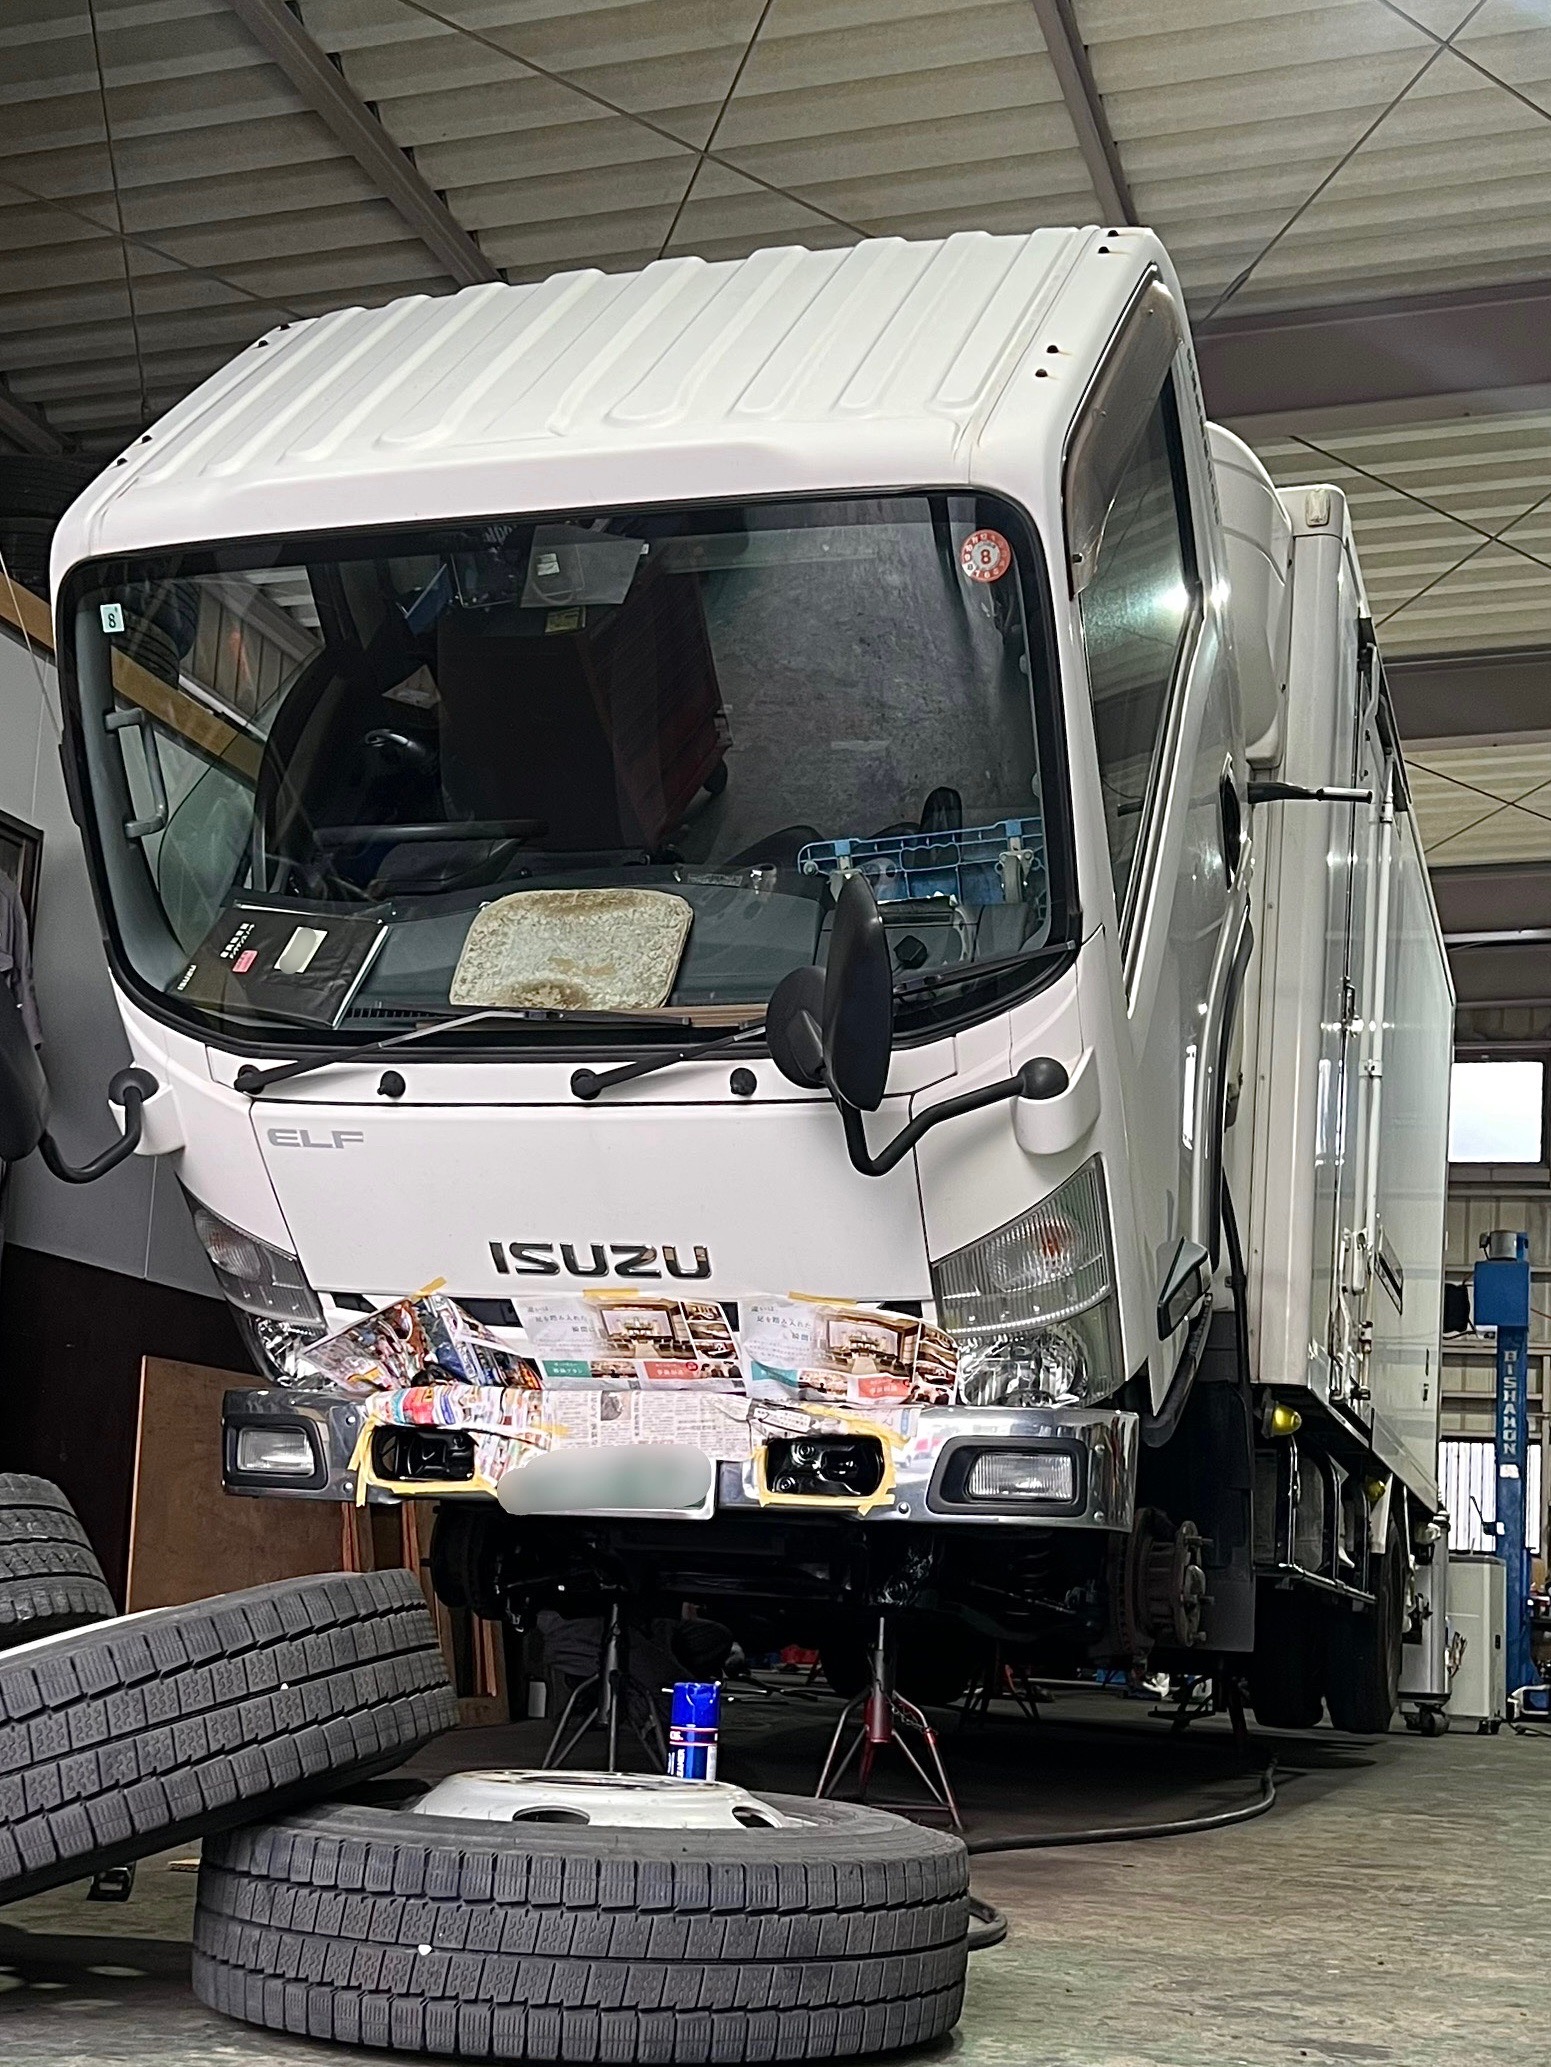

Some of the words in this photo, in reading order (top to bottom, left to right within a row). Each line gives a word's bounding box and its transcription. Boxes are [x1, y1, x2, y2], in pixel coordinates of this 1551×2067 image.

[981, 549, 991, 565] 8
[108, 613, 116, 629] 8
[267, 1128, 364, 1149] ELF
[488, 1240, 713, 1280] ISUZU
[1503, 1350, 1517, 1455] BISHAMON
